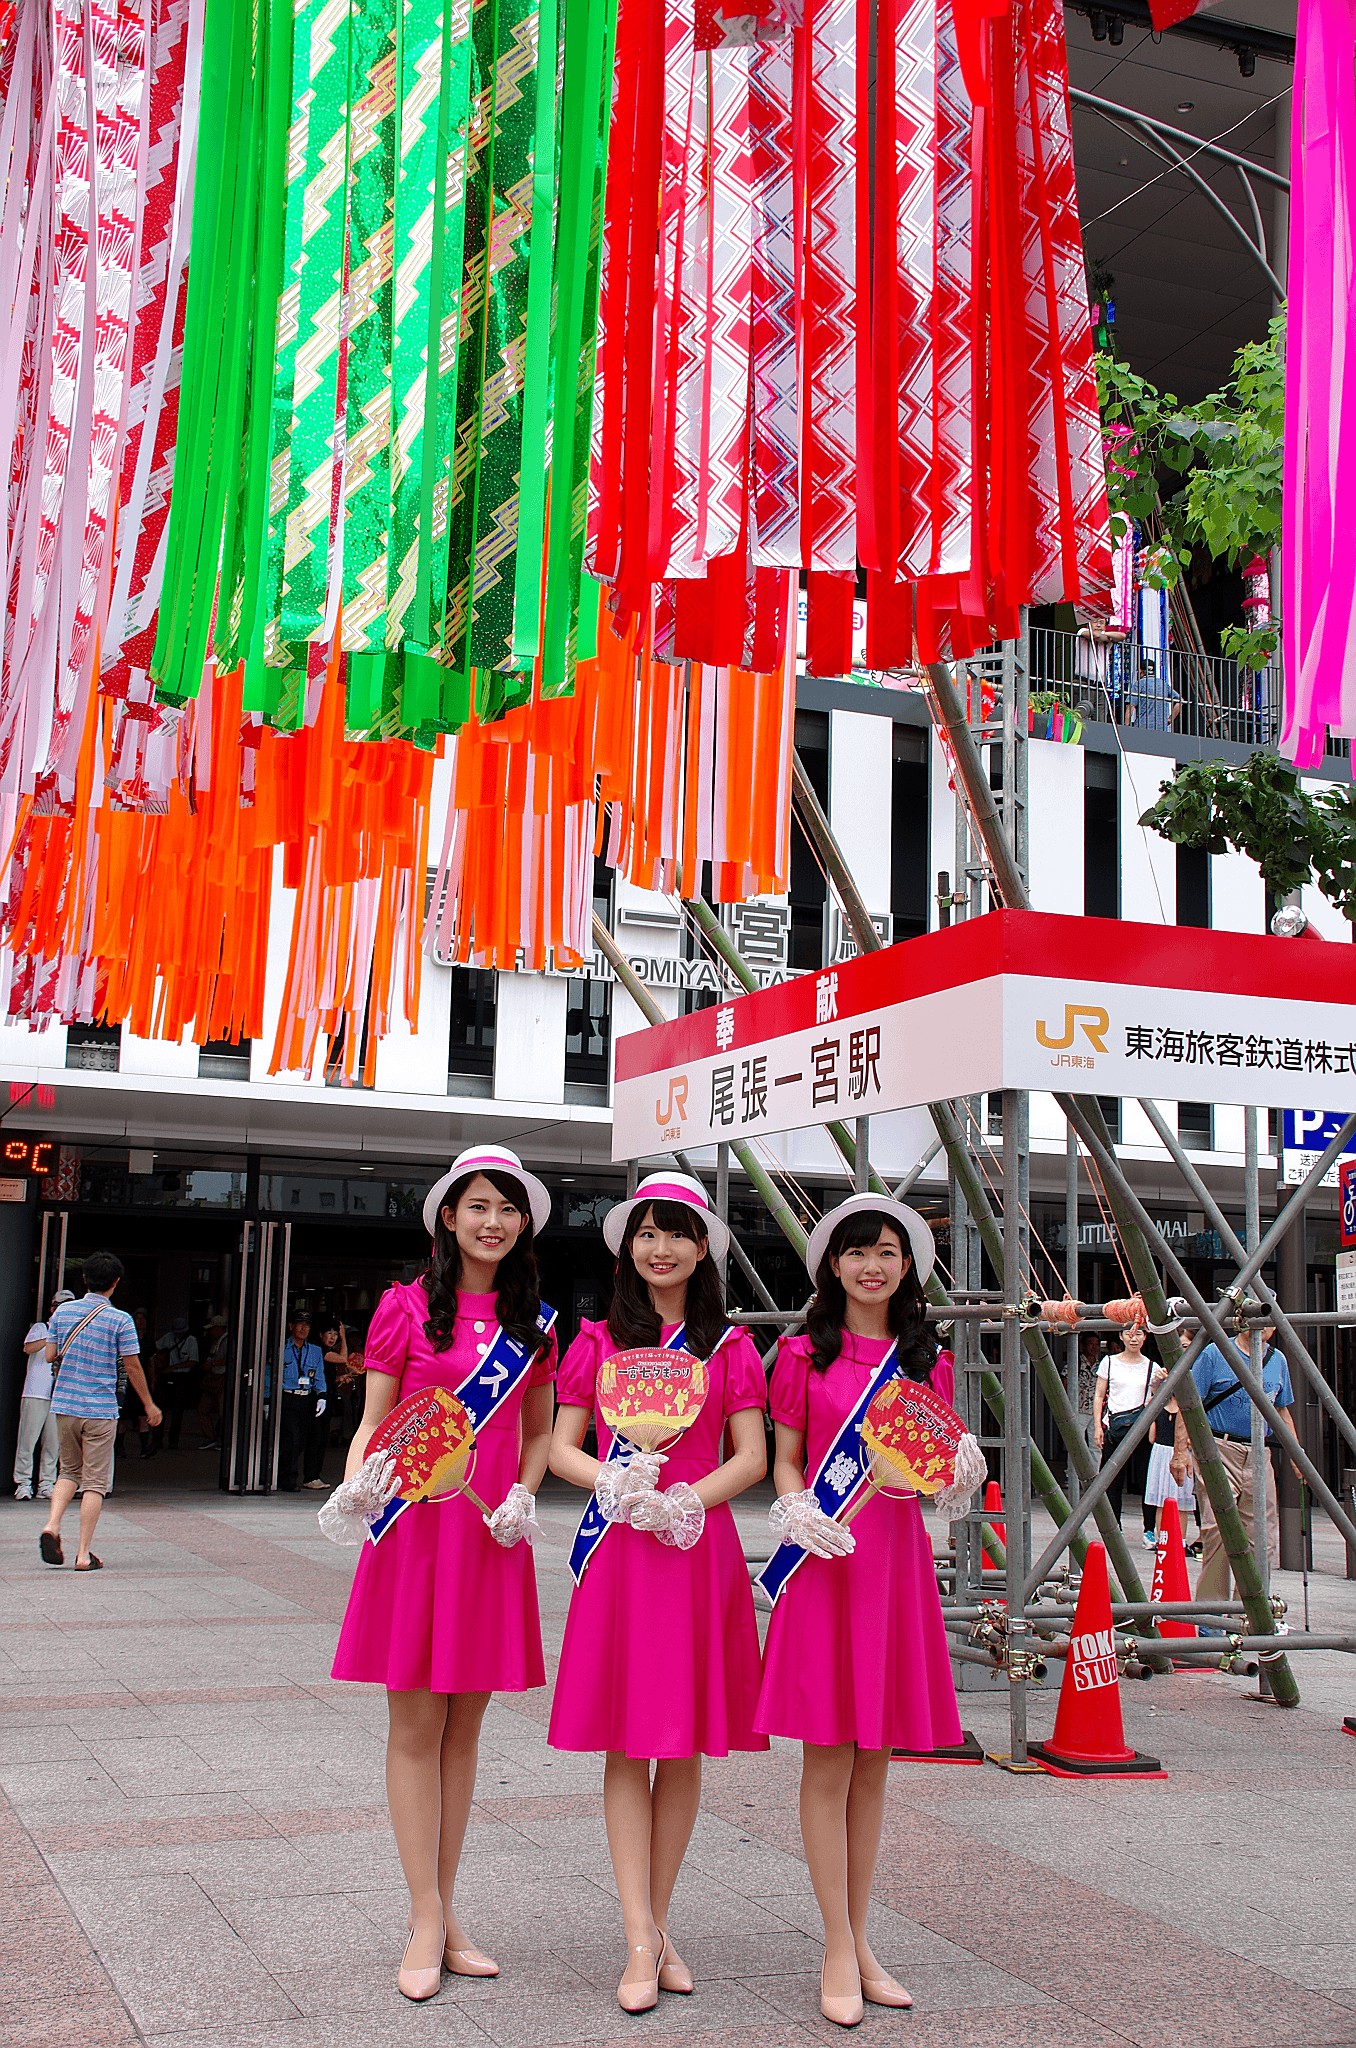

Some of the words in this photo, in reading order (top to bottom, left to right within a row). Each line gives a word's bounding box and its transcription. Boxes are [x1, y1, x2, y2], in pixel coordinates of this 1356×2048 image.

[1036, 1003, 1110, 1053] JR
[709, 1025, 882, 1129] 尾張一宮駅
[1050, 1053, 1095, 1070] JR東海
[655, 1074, 689, 1126] JR
[660, 1126, 681, 1143] JR東海
[1294, 1109, 1325, 1145] P
[616, 1365, 691, 1379] 一宮七夕まつり
